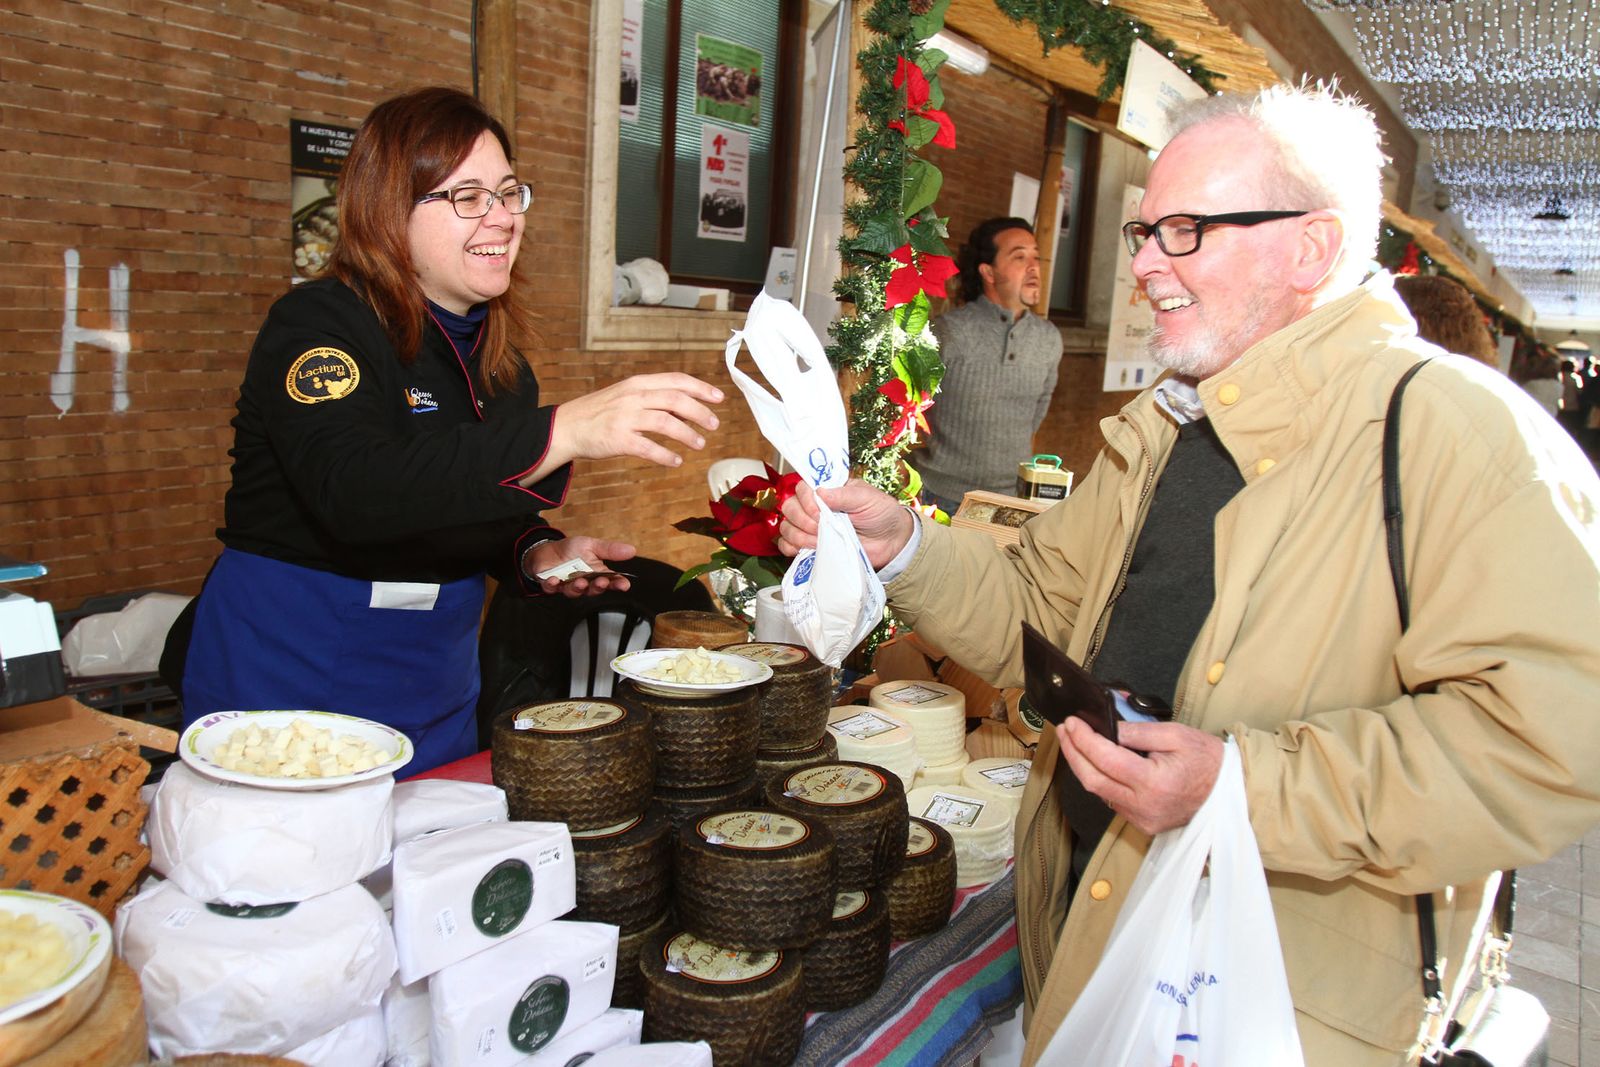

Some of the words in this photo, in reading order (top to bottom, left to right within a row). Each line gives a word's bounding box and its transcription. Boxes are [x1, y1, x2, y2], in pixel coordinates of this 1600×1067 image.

[308, 127, 336, 137] MUESTRA
[337, 131, 348, 139] DEL
[307, 144, 315, 152] DE
[299, 364, 345, 379] Lactium
